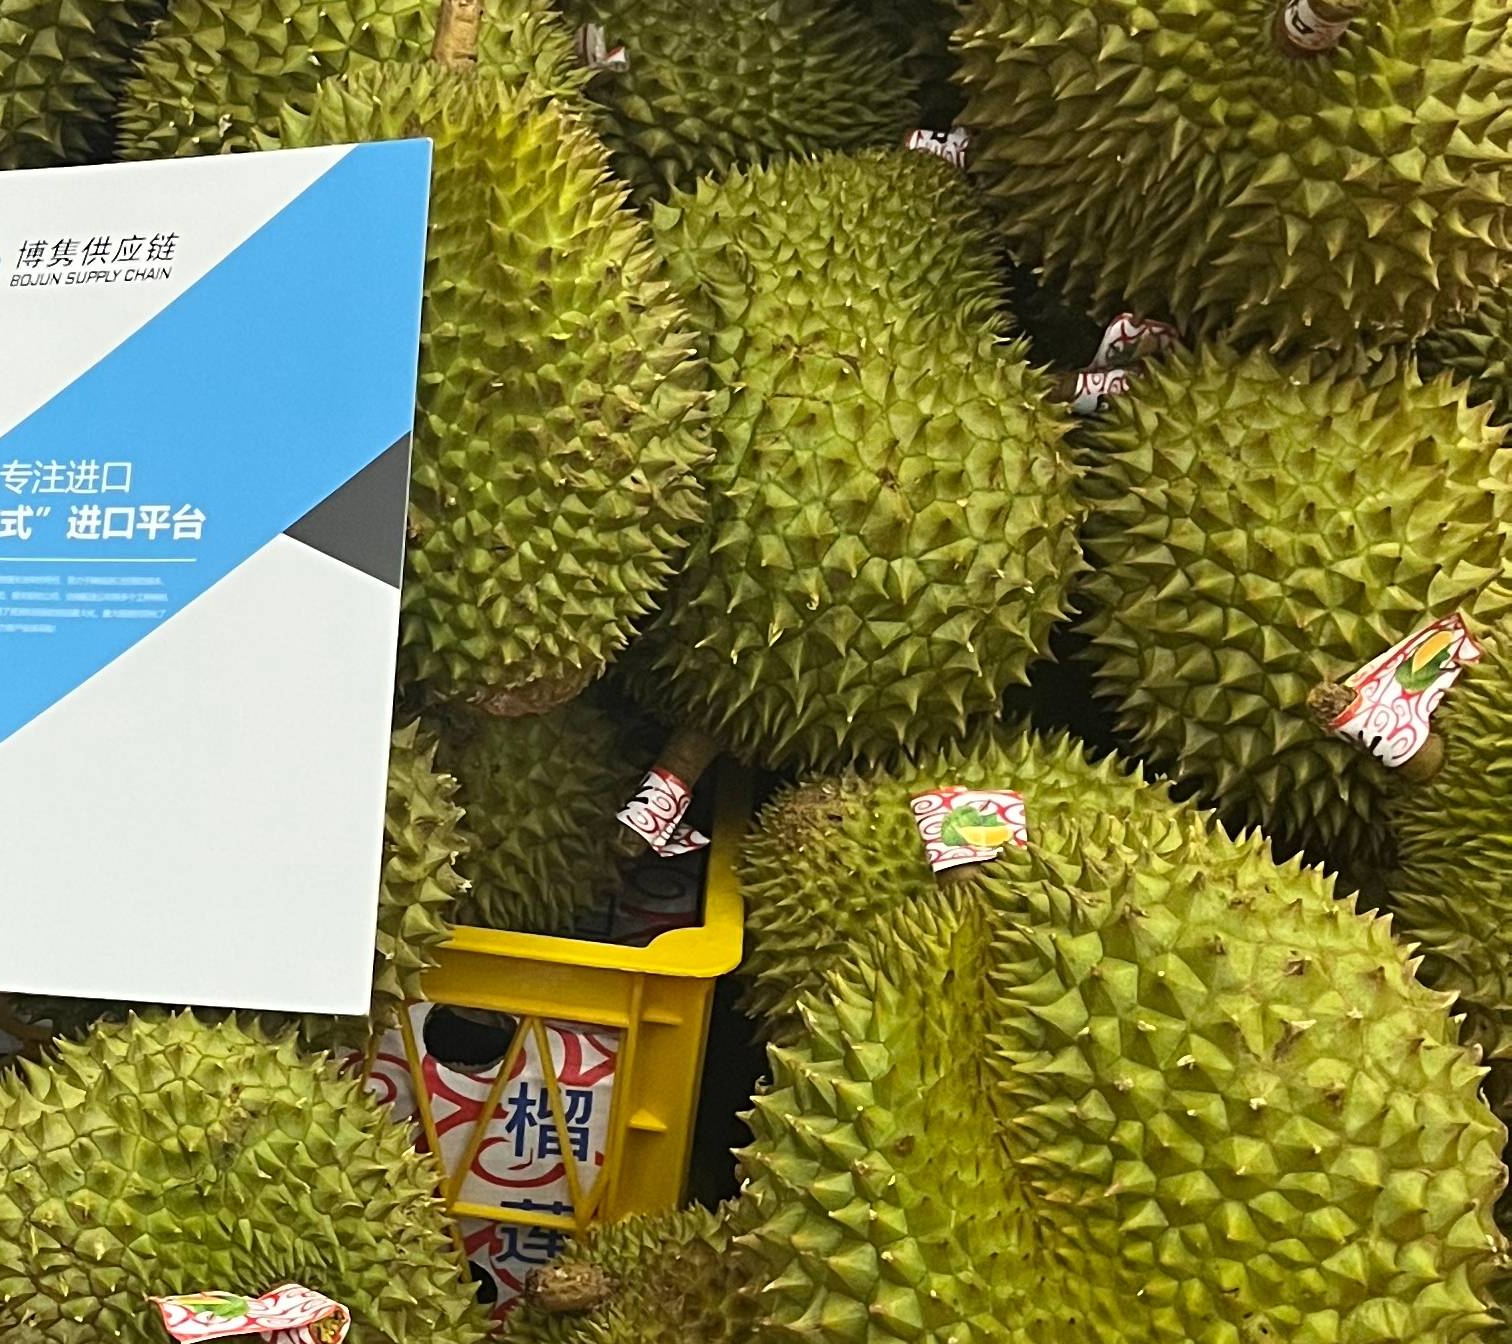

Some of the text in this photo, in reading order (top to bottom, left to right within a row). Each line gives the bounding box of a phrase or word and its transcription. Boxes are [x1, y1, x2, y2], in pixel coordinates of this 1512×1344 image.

[16, 232, 180, 269] 博隽供应链
[9, 265, 173, 288] BOJUN SUPPLY CHAIN
